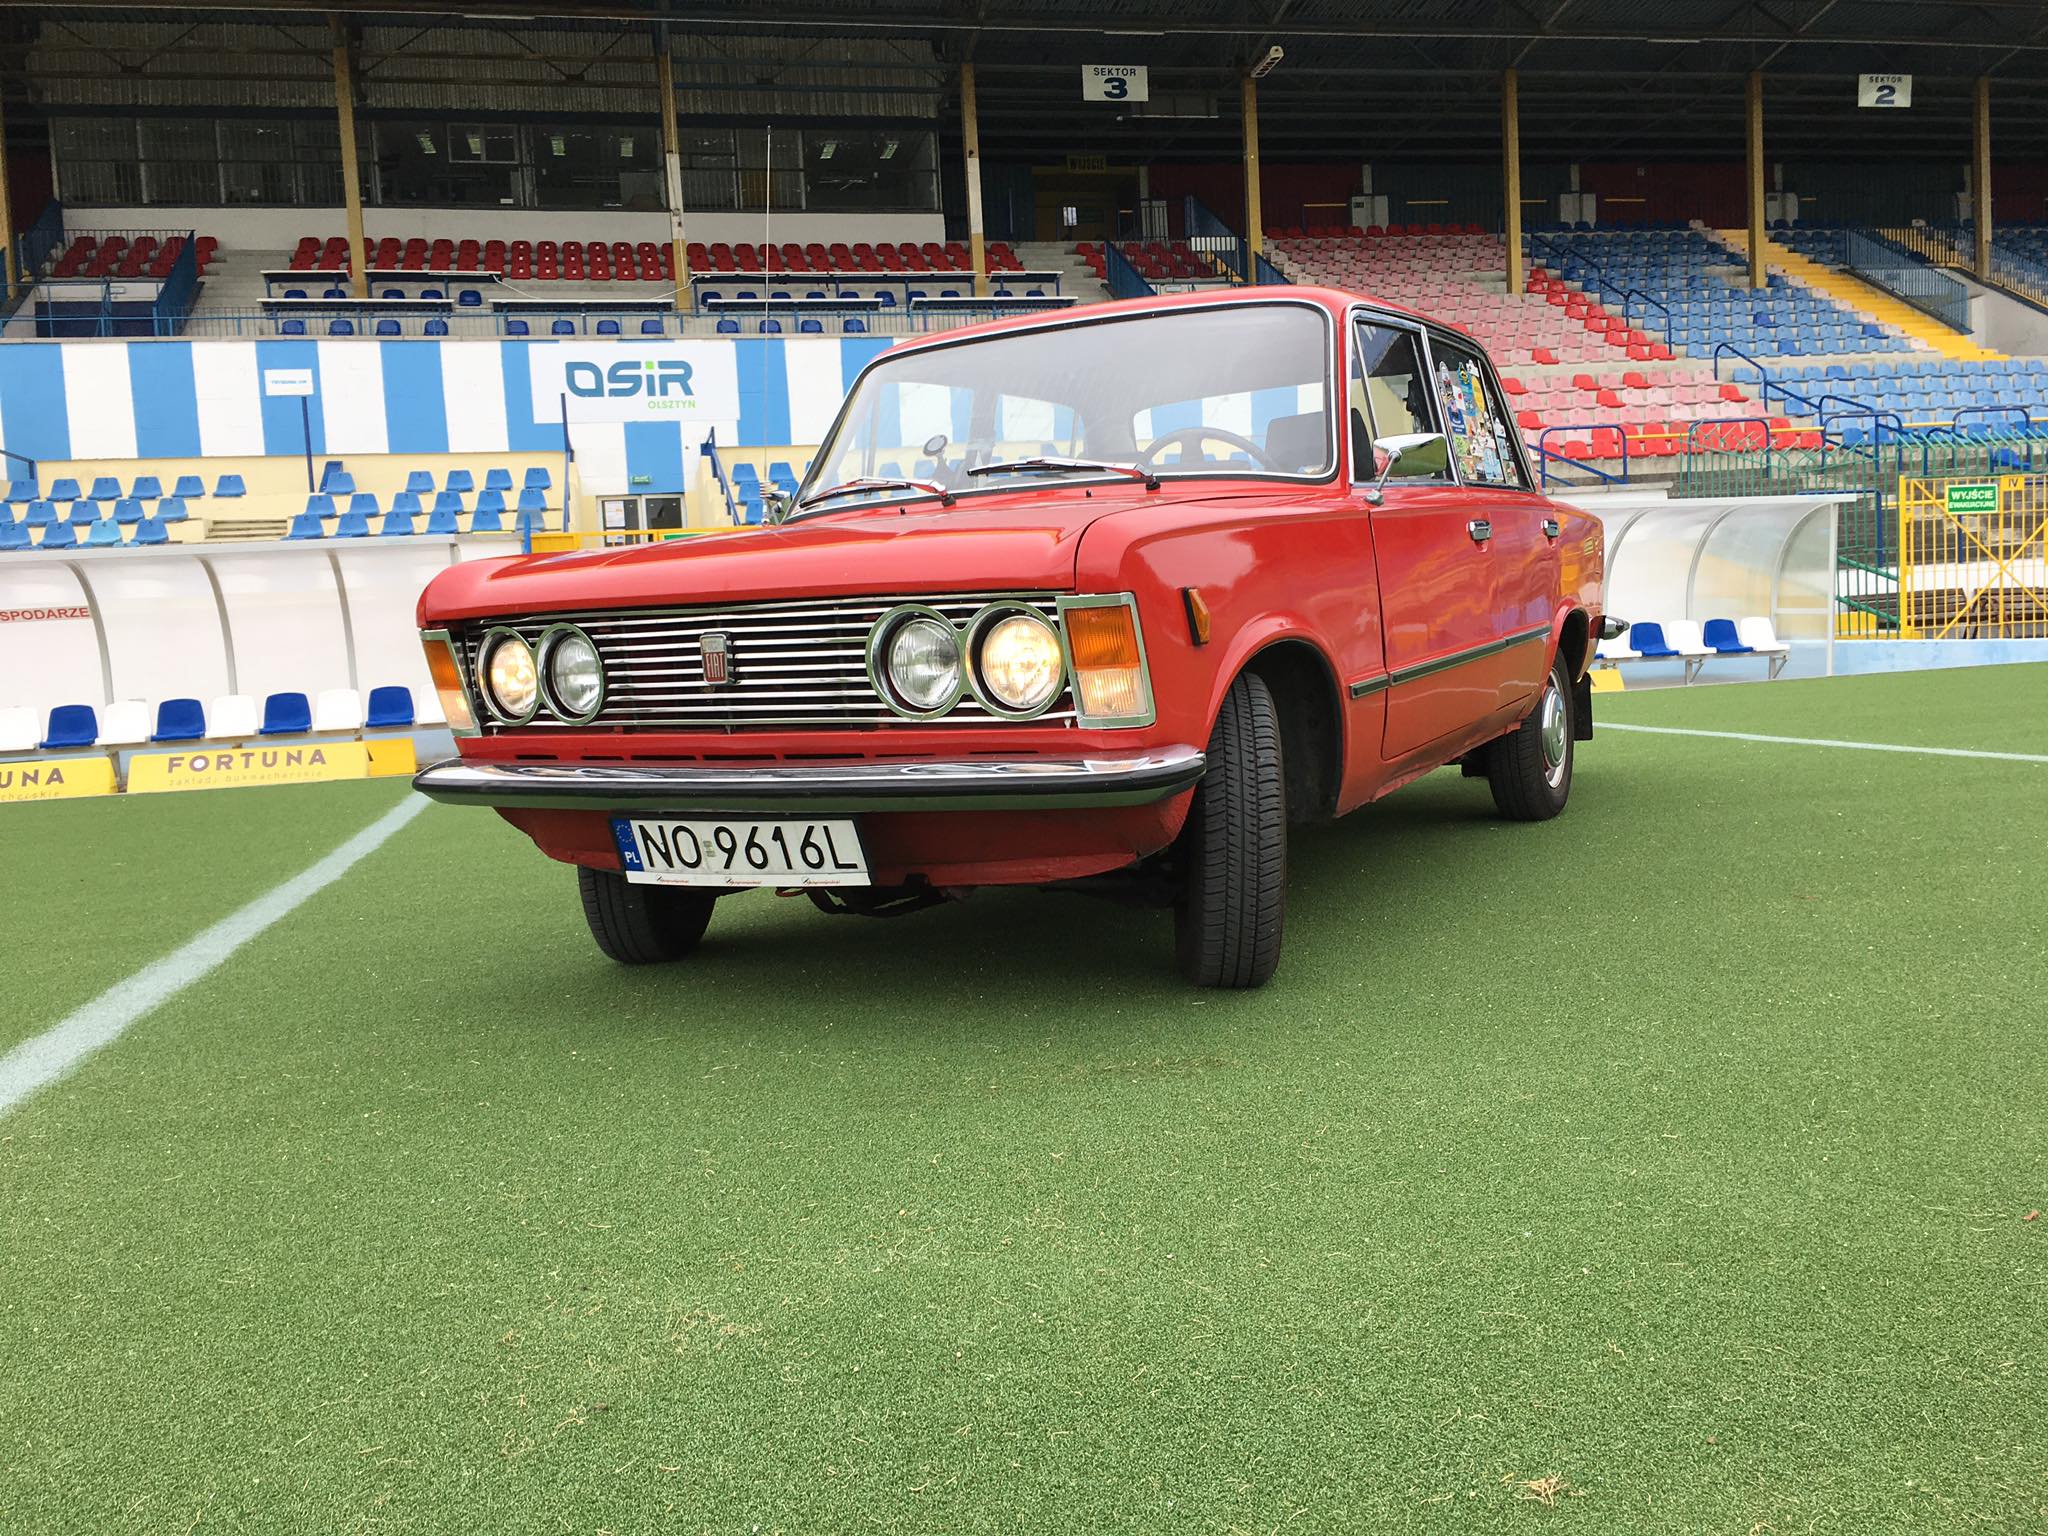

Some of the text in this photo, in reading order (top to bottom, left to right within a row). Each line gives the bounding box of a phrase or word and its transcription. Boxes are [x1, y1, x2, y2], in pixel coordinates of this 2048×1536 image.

[1093, 67, 1136, 76] SEKTOR
[1103, 77, 1128, 99] 3
[1875, 84, 1896, 105] 2
[647, 400, 696, 409] OLSZTYN
[2008, 478, 2019, 488] IV
[1951, 489, 1994, 500] WYJŚCIE
[705, 653, 724, 678] FIAT
[167, 749, 326, 774] FORTUNA
[638, 824, 858, 870] NO 9616L
[624, 851, 640, 863] PL
